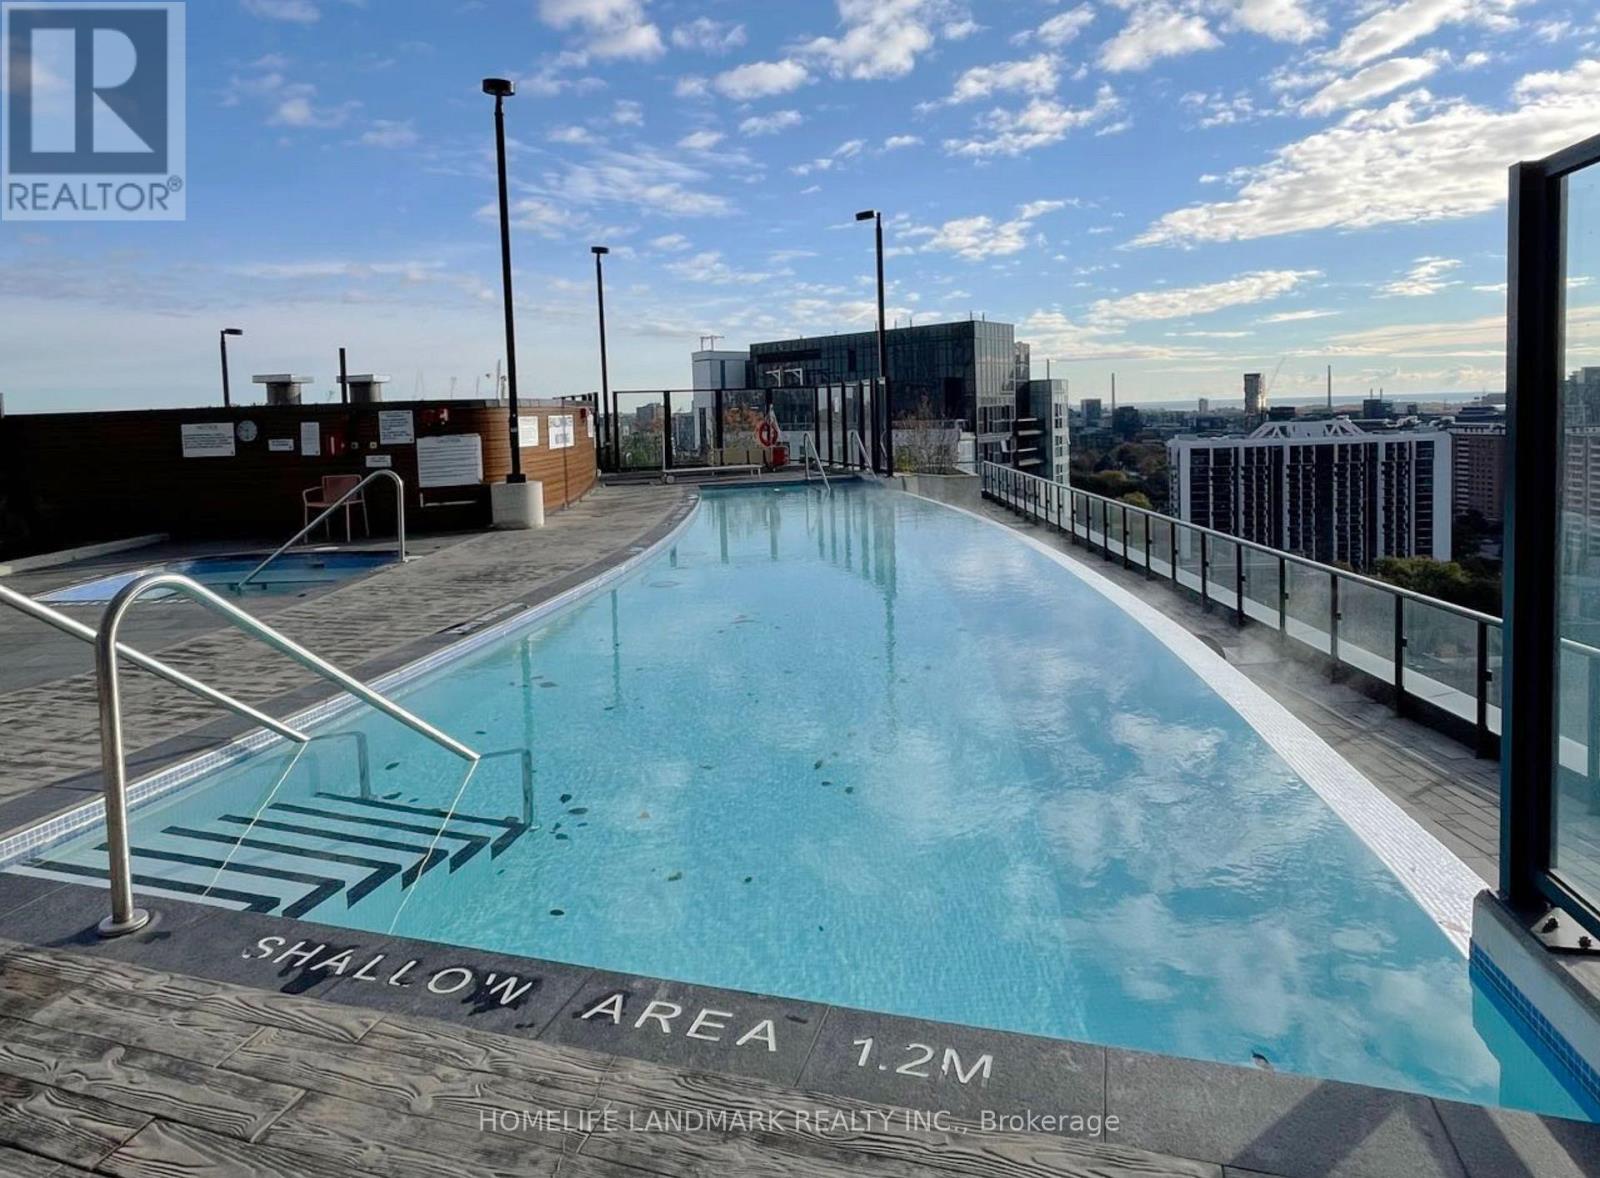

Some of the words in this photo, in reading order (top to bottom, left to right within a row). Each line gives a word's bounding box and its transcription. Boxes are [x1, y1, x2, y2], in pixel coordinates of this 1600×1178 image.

[242, 936, 532, 1005] SHALLOW
[581, 993, 778, 1052] AREA
[853, 1037, 994, 1085] 1.2M
